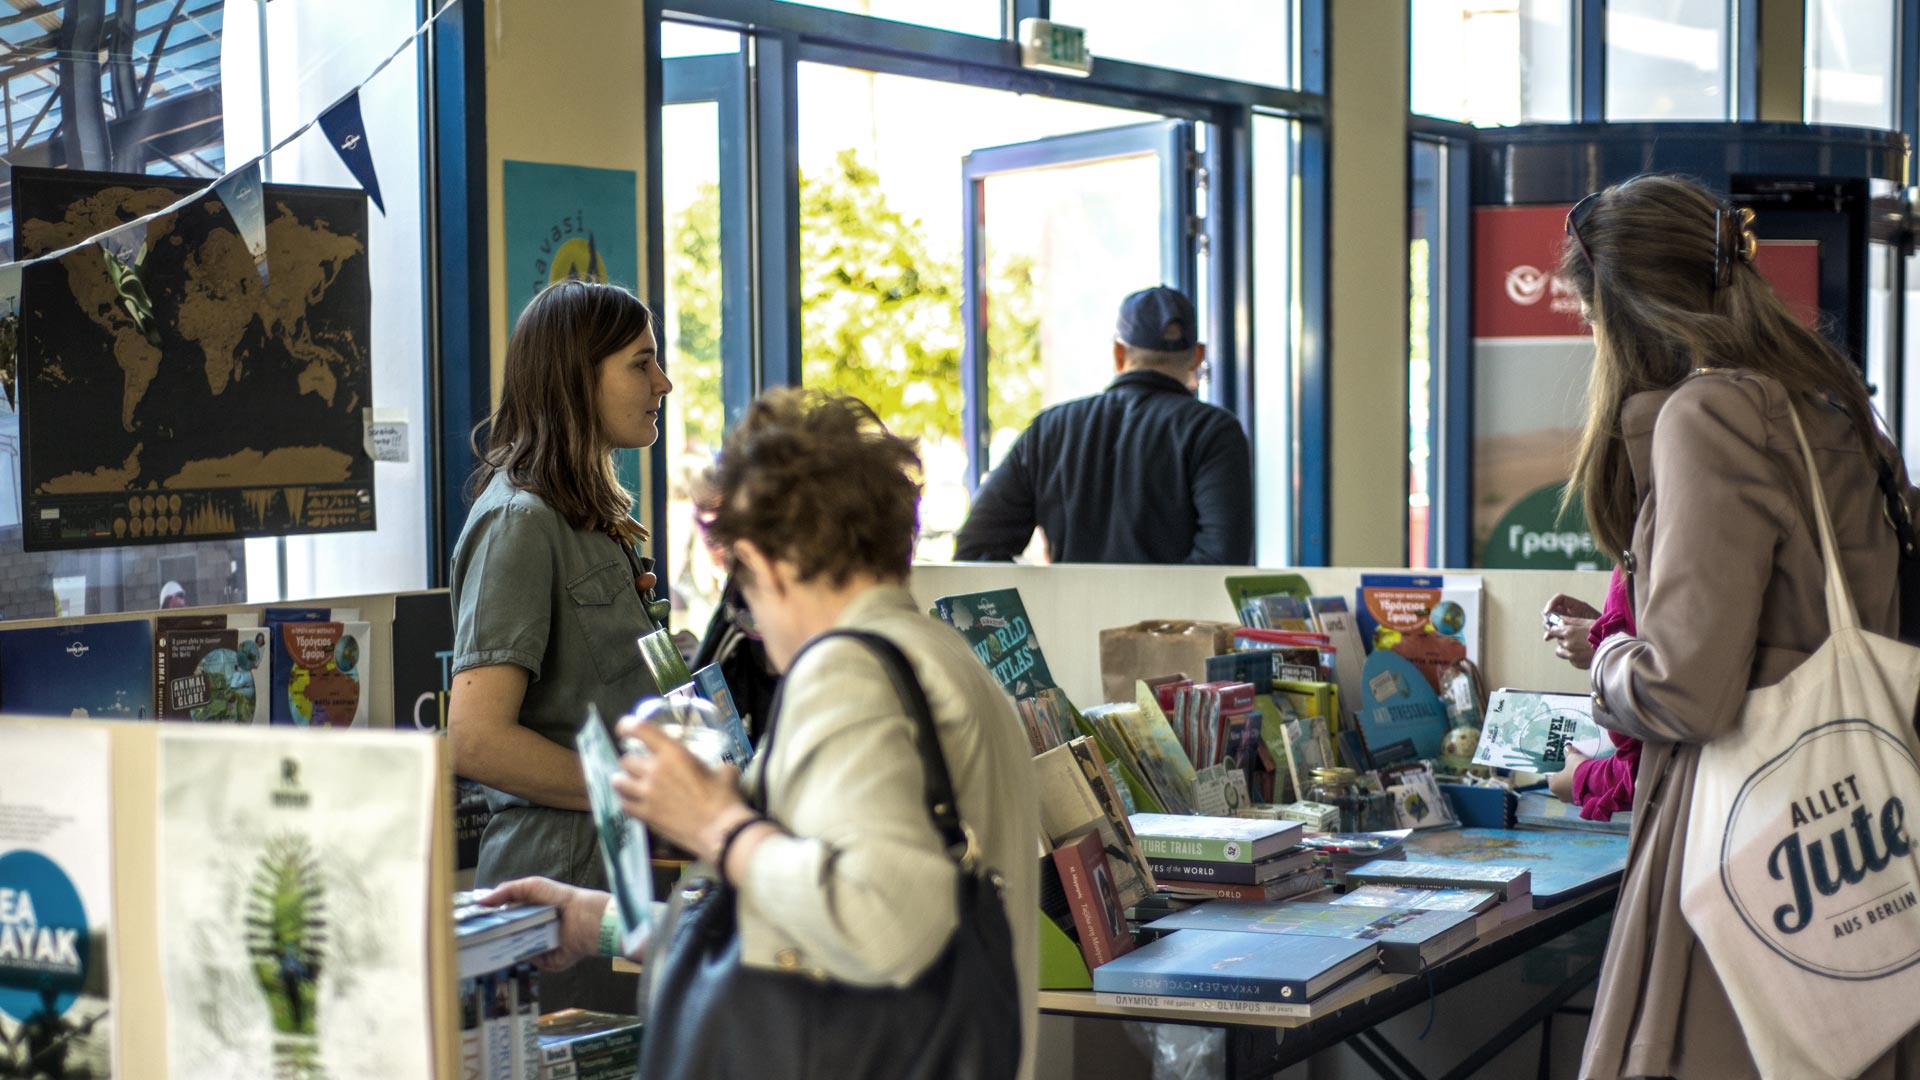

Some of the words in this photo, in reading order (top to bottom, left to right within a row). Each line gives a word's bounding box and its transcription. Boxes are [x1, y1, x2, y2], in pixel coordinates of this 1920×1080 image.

[158, 651, 166, 685] ANIMAL
[174, 675, 205, 691] ANIMAL
[178, 691, 204, 707] GLOBE
[414, 690, 452, 732] CI
[1543, 716, 1565, 762] TRAVEL
[1790, 774, 1861, 829] ALLET
[1139, 839, 1167, 853] TURE
[1169, 841, 1203, 856] TRAILS
[1183, 866, 1215, 876] WORLD
[1767, 796, 1911, 935] Jute
[1216, 889, 1241, 899] ORLD
[1833, 916, 1863, 938] AUS
[1866, 890, 1919, 925] BERLIN
[0, 924, 80, 967] AYAK
[1115, 995, 1159, 1007] ΟΛΥΜΠΟΣ
[1217, 1001, 1261, 1012] OLYMPUS
